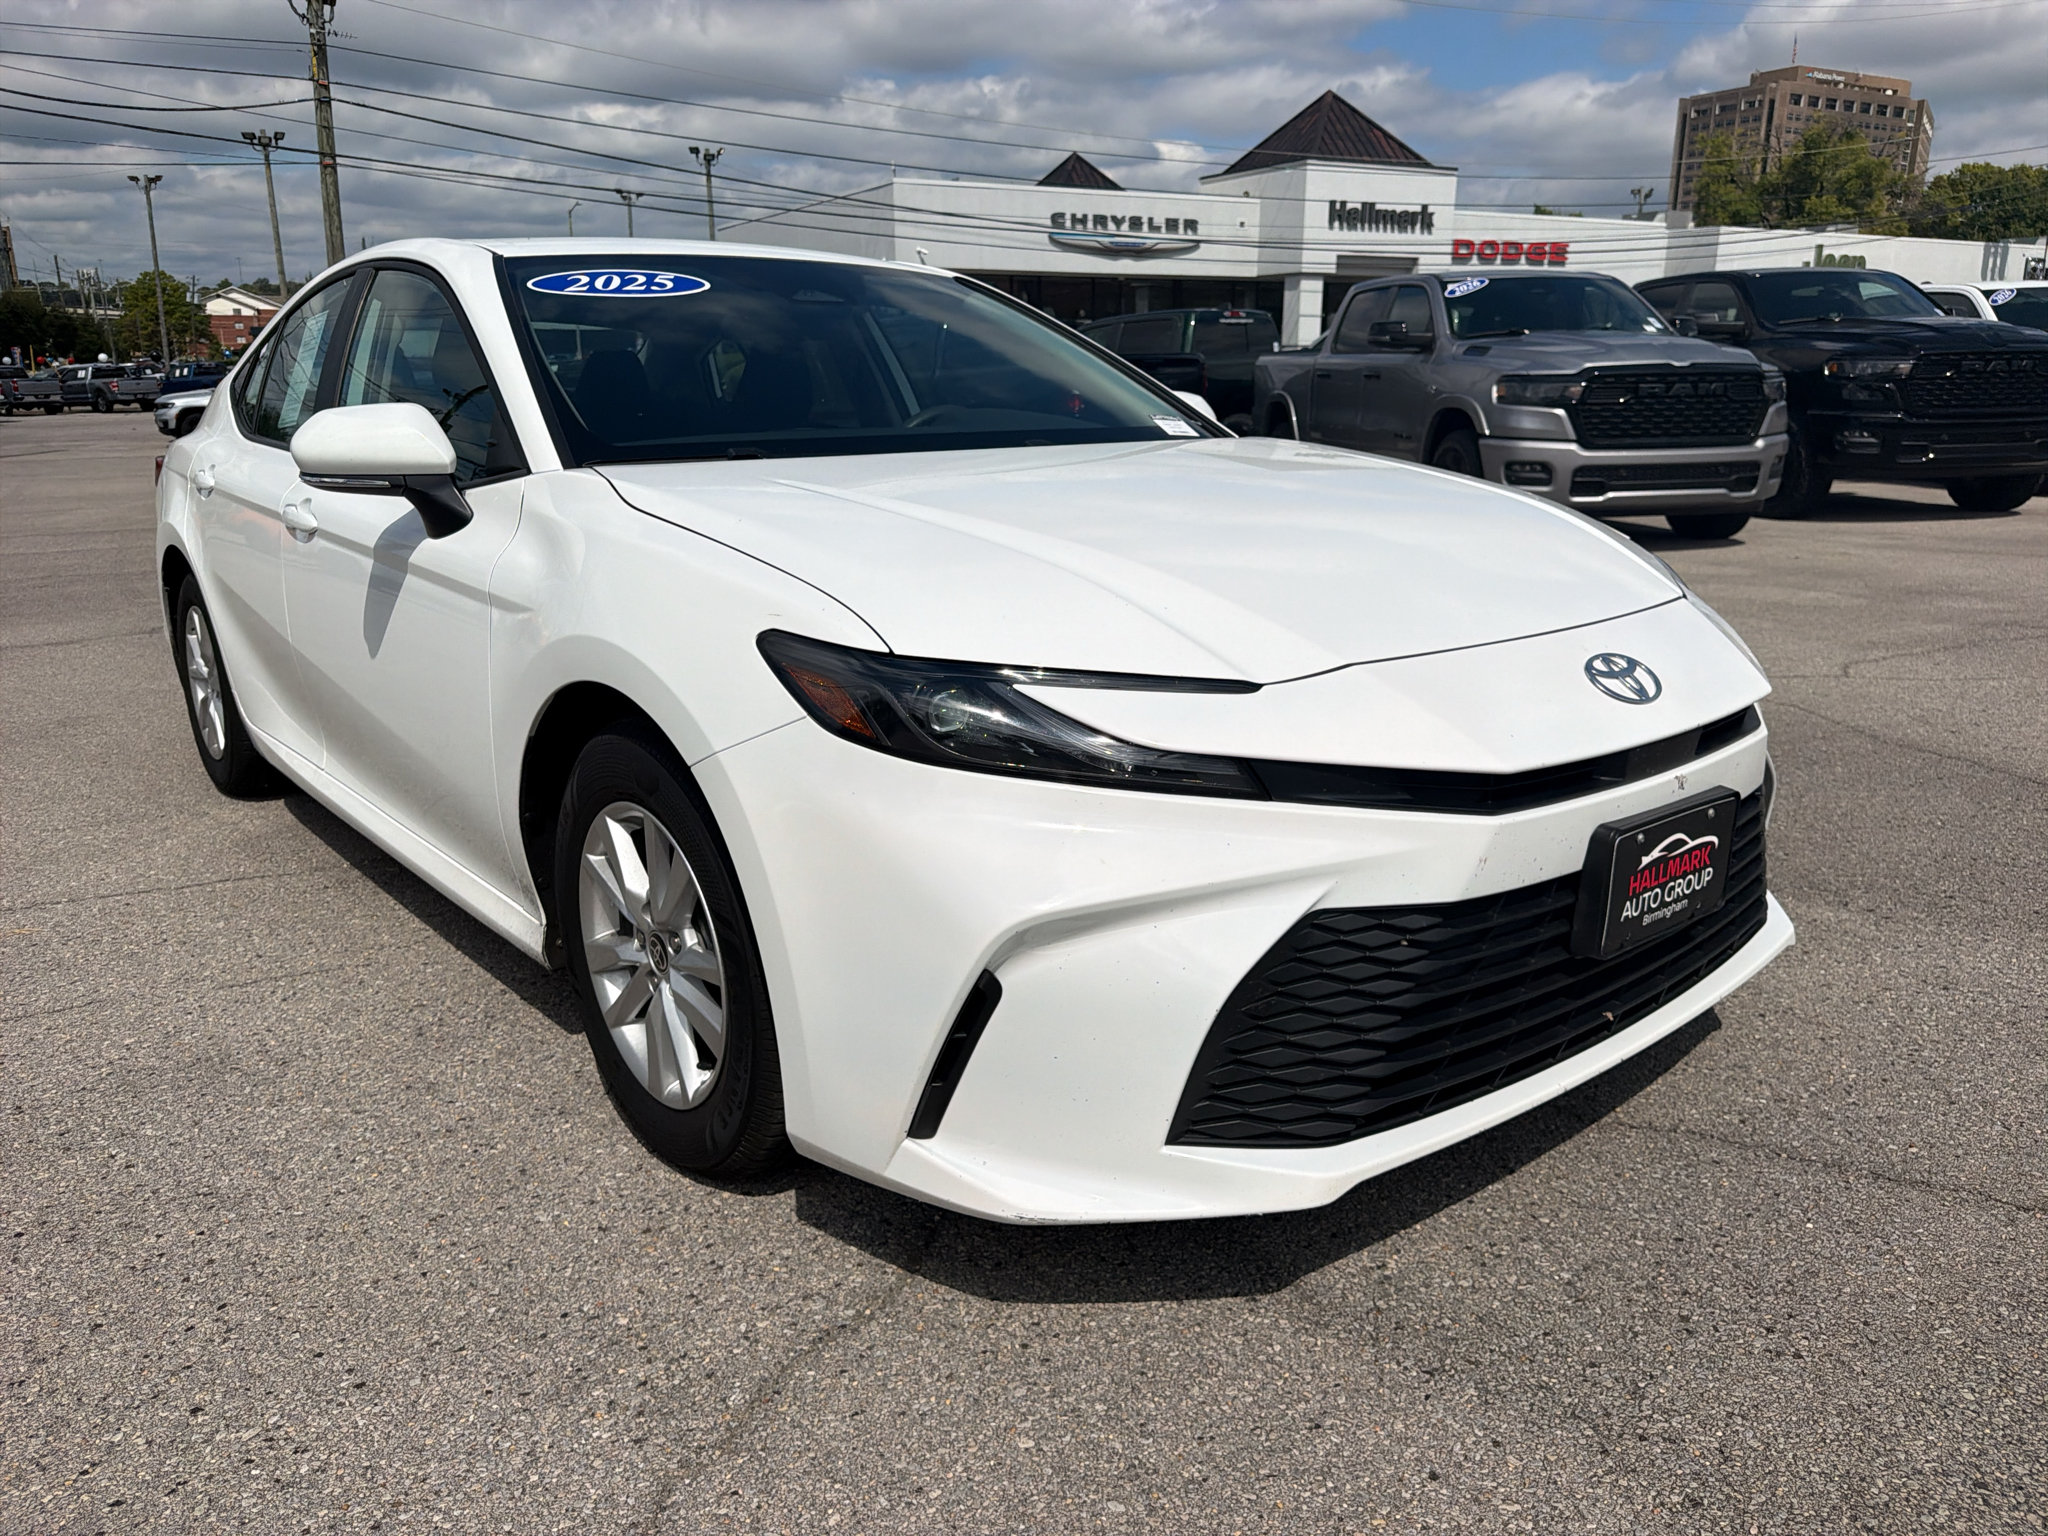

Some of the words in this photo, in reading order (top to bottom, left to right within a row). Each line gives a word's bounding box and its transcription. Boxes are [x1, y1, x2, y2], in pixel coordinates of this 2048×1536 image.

[1051, 212, 1199, 235] CHRYSLER
[1329, 200, 1435, 233] Hallmark
[1452, 239, 1569, 262] DODGE
[564, 274, 675, 292] 2025
[1960, 359, 2035, 372] RAM
[1638, 382, 1725, 397] RAM
[1629, 845, 1711, 896] HALLMARK
[1620, 889, 1661, 922] AUTO
[1665, 867, 1713, 901] GROUP
[1642, 899, 1688, 926] Birmingham
